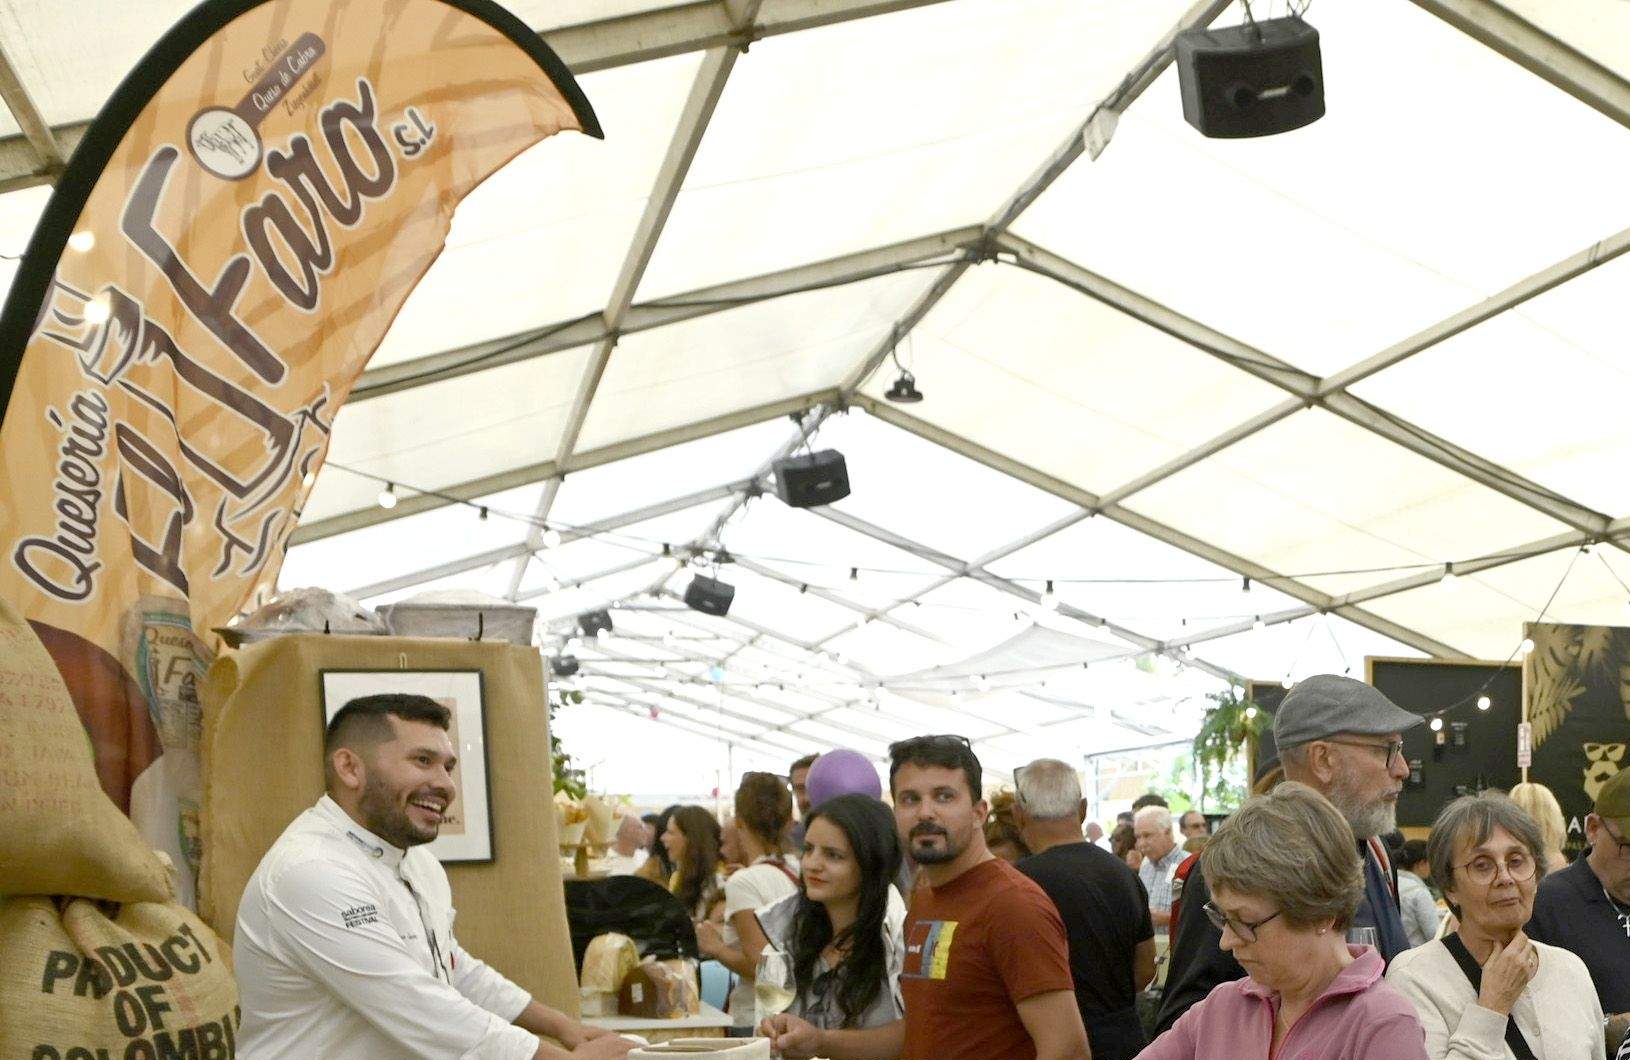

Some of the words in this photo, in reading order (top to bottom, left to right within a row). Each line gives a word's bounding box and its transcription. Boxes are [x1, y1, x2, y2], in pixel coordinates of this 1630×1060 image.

[279, 70, 291, 88] de
[122, 78, 394, 384] Faro
[15, 390, 109, 601] Quesería
[113, 984, 173, 1038] OF
